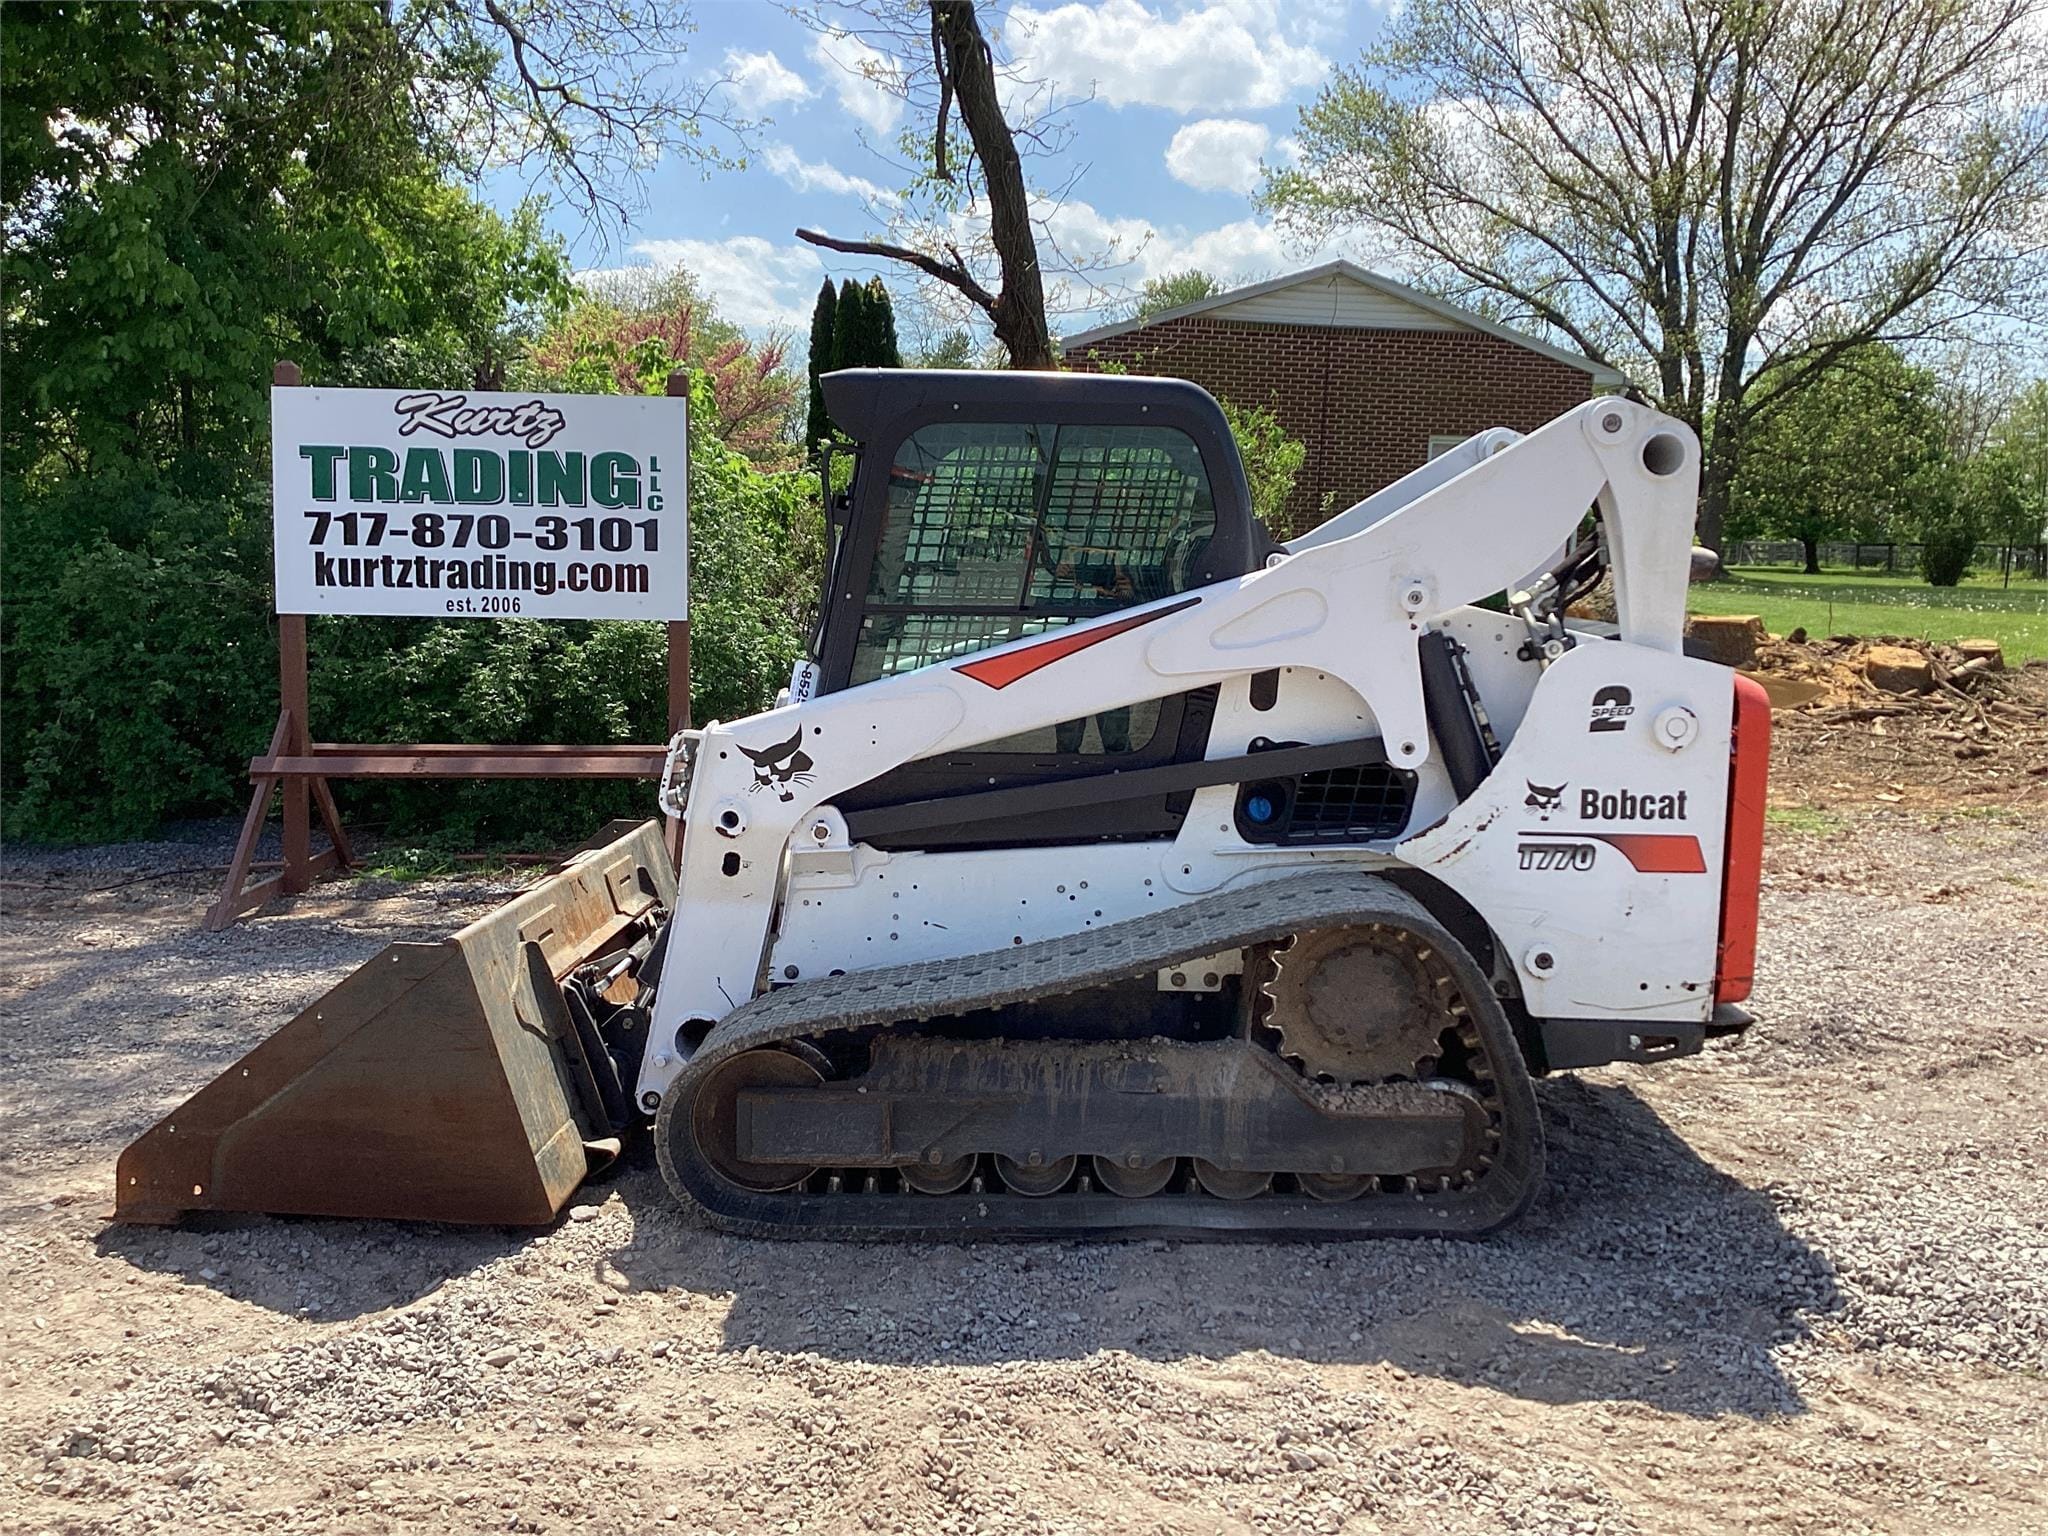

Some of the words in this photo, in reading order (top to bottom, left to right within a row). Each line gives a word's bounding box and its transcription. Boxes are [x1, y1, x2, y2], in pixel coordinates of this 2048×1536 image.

[394, 392, 566, 449] Kurtz
[299, 444, 641, 510] TRADING
[648, 455, 664, 511] LLC
[303, 511, 659, 552] 717-870-3101
[314, 551, 650, 595] kurtztrading.com
[445, 598, 477, 613] est.
[481, 596, 521, 614] 2006
[1589, 684, 1633, 733] 2
[1591, 705, 1635, 718] SPEED
[1580, 788, 1688, 821] Bobcat
[1518, 842, 1597, 872] T770
